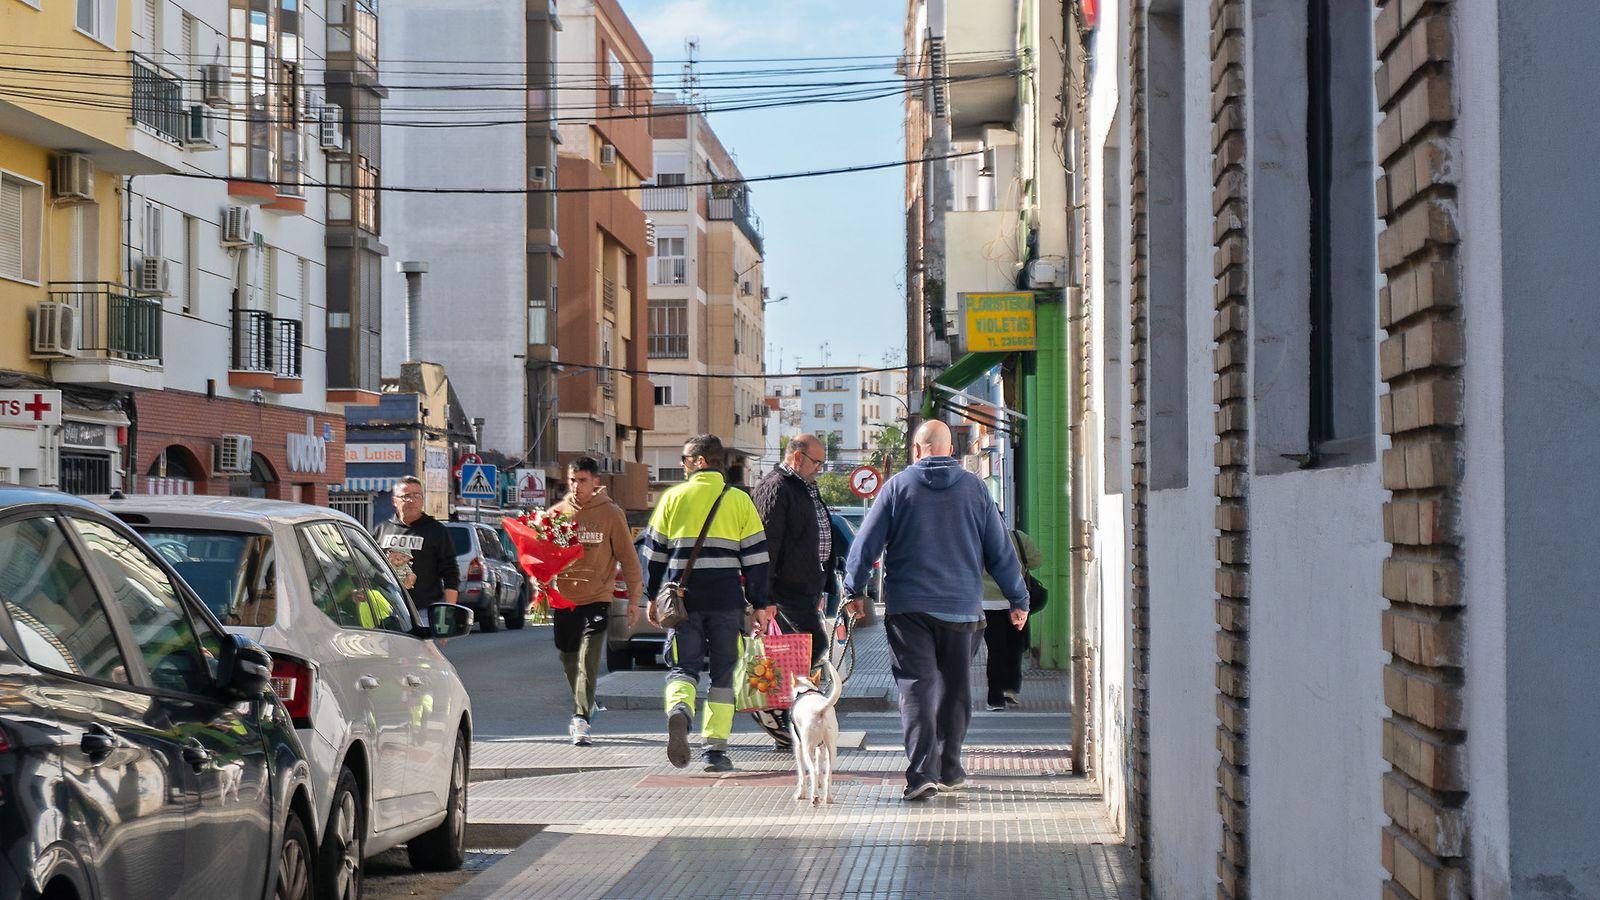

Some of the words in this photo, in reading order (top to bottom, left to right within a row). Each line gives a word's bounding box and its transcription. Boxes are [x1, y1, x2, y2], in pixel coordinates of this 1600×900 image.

[975, 317, 1031, 333] VIOLETAS
[363, 444, 403, 461] Luisa
[384, 535, 417, 549] ICON
